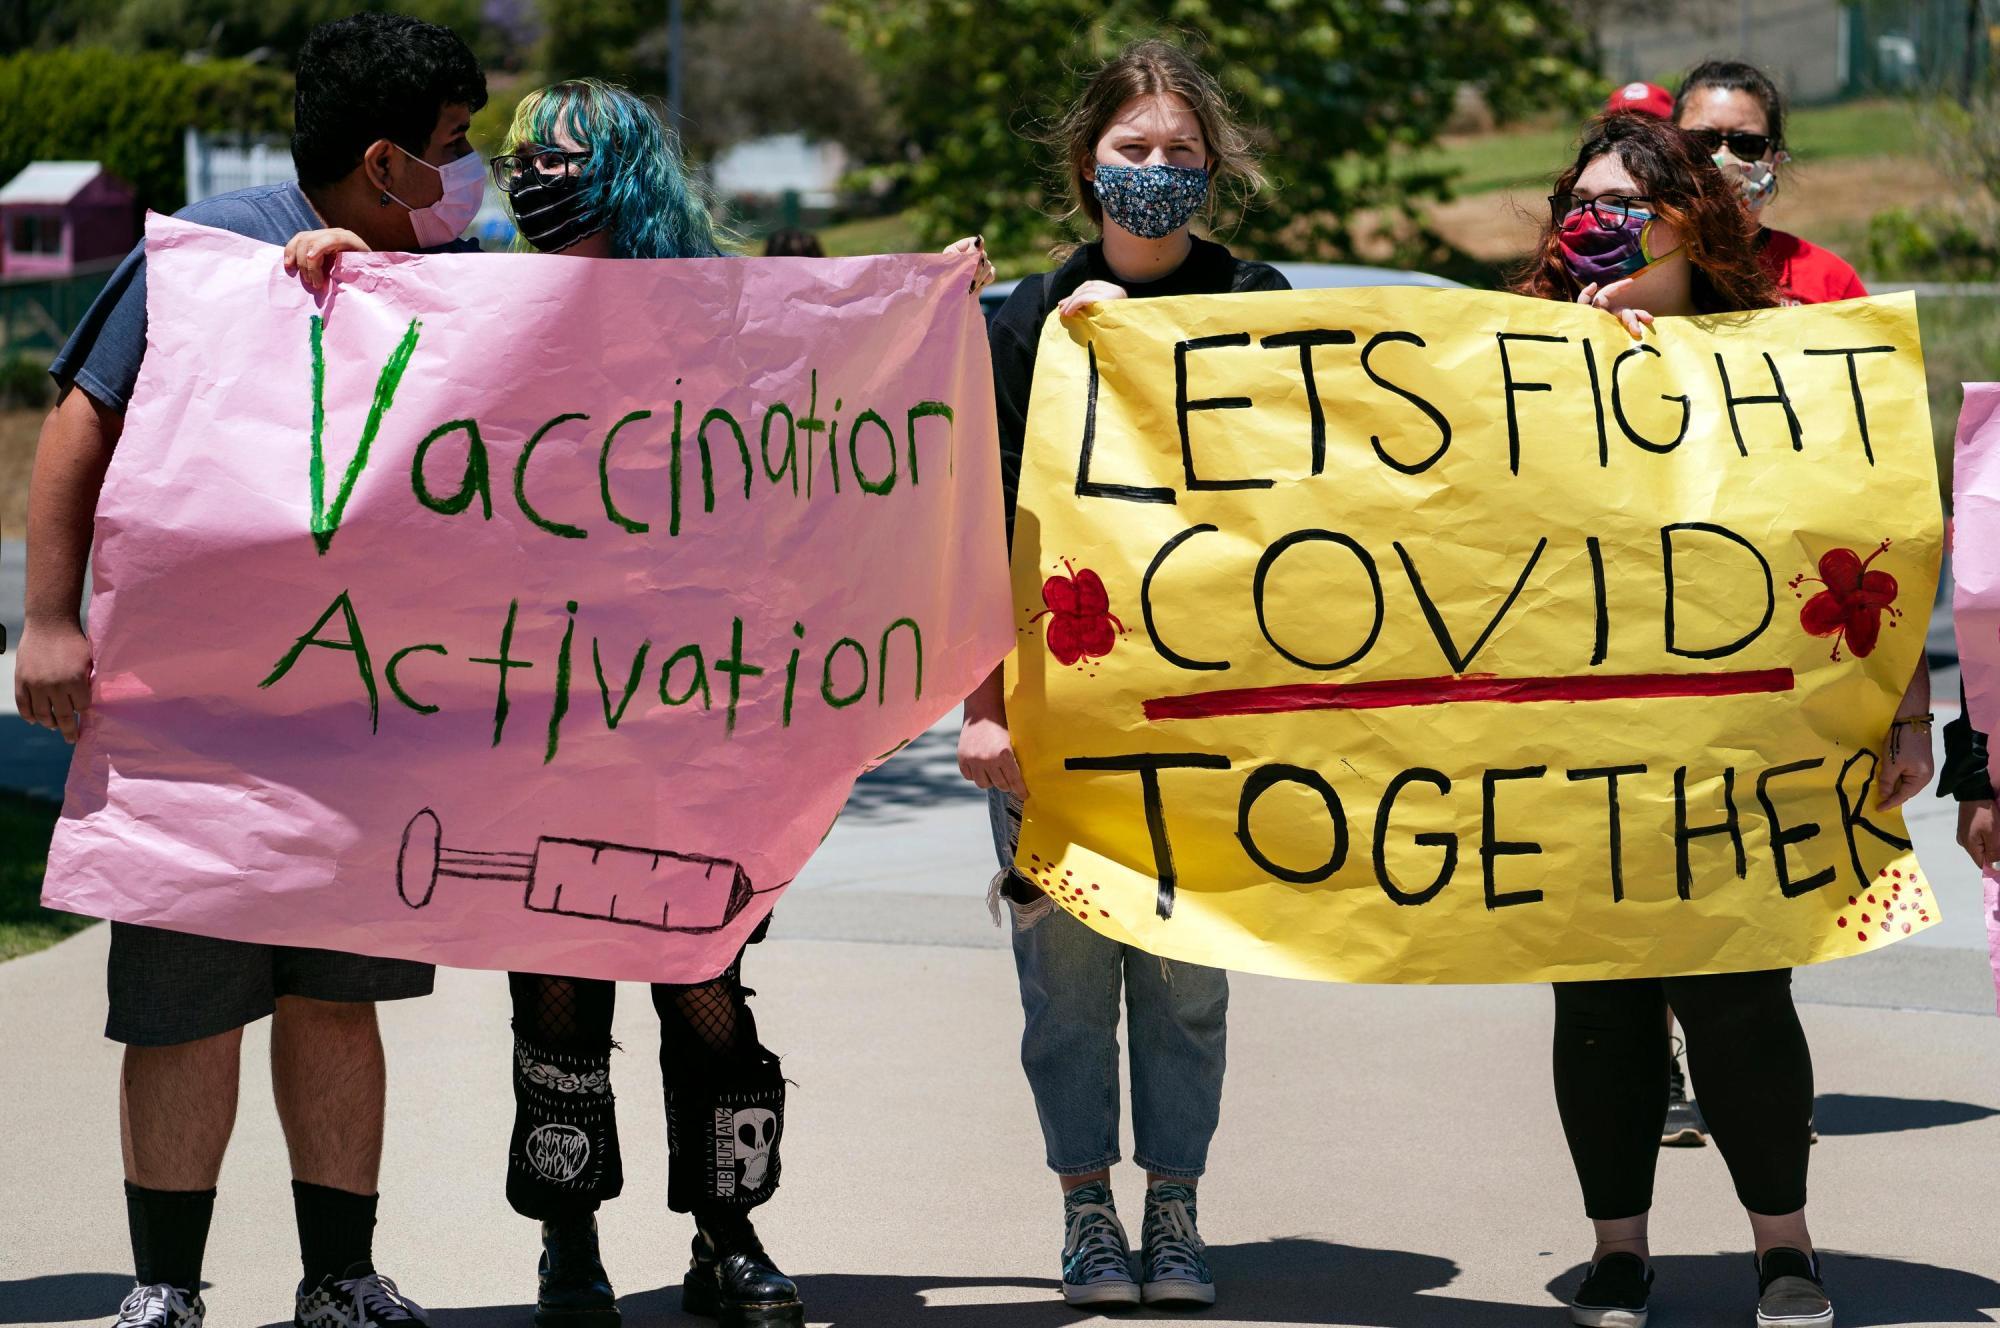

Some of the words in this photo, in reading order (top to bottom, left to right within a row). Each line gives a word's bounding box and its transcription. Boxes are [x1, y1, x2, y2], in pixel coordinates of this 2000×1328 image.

[309, 314, 955, 556] Vaccination
[1074, 328, 1452, 505] LETS
[1495, 330, 1898, 477] FIGHT
[257, 588, 924, 766] Activation
[1140, 521, 1776, 674] COVID
[1064, 746, 1912, 921] TOGETHER
[534, 1128, 587, 1156] HORROR
[534, 1146, 582, 1178] SHOW
